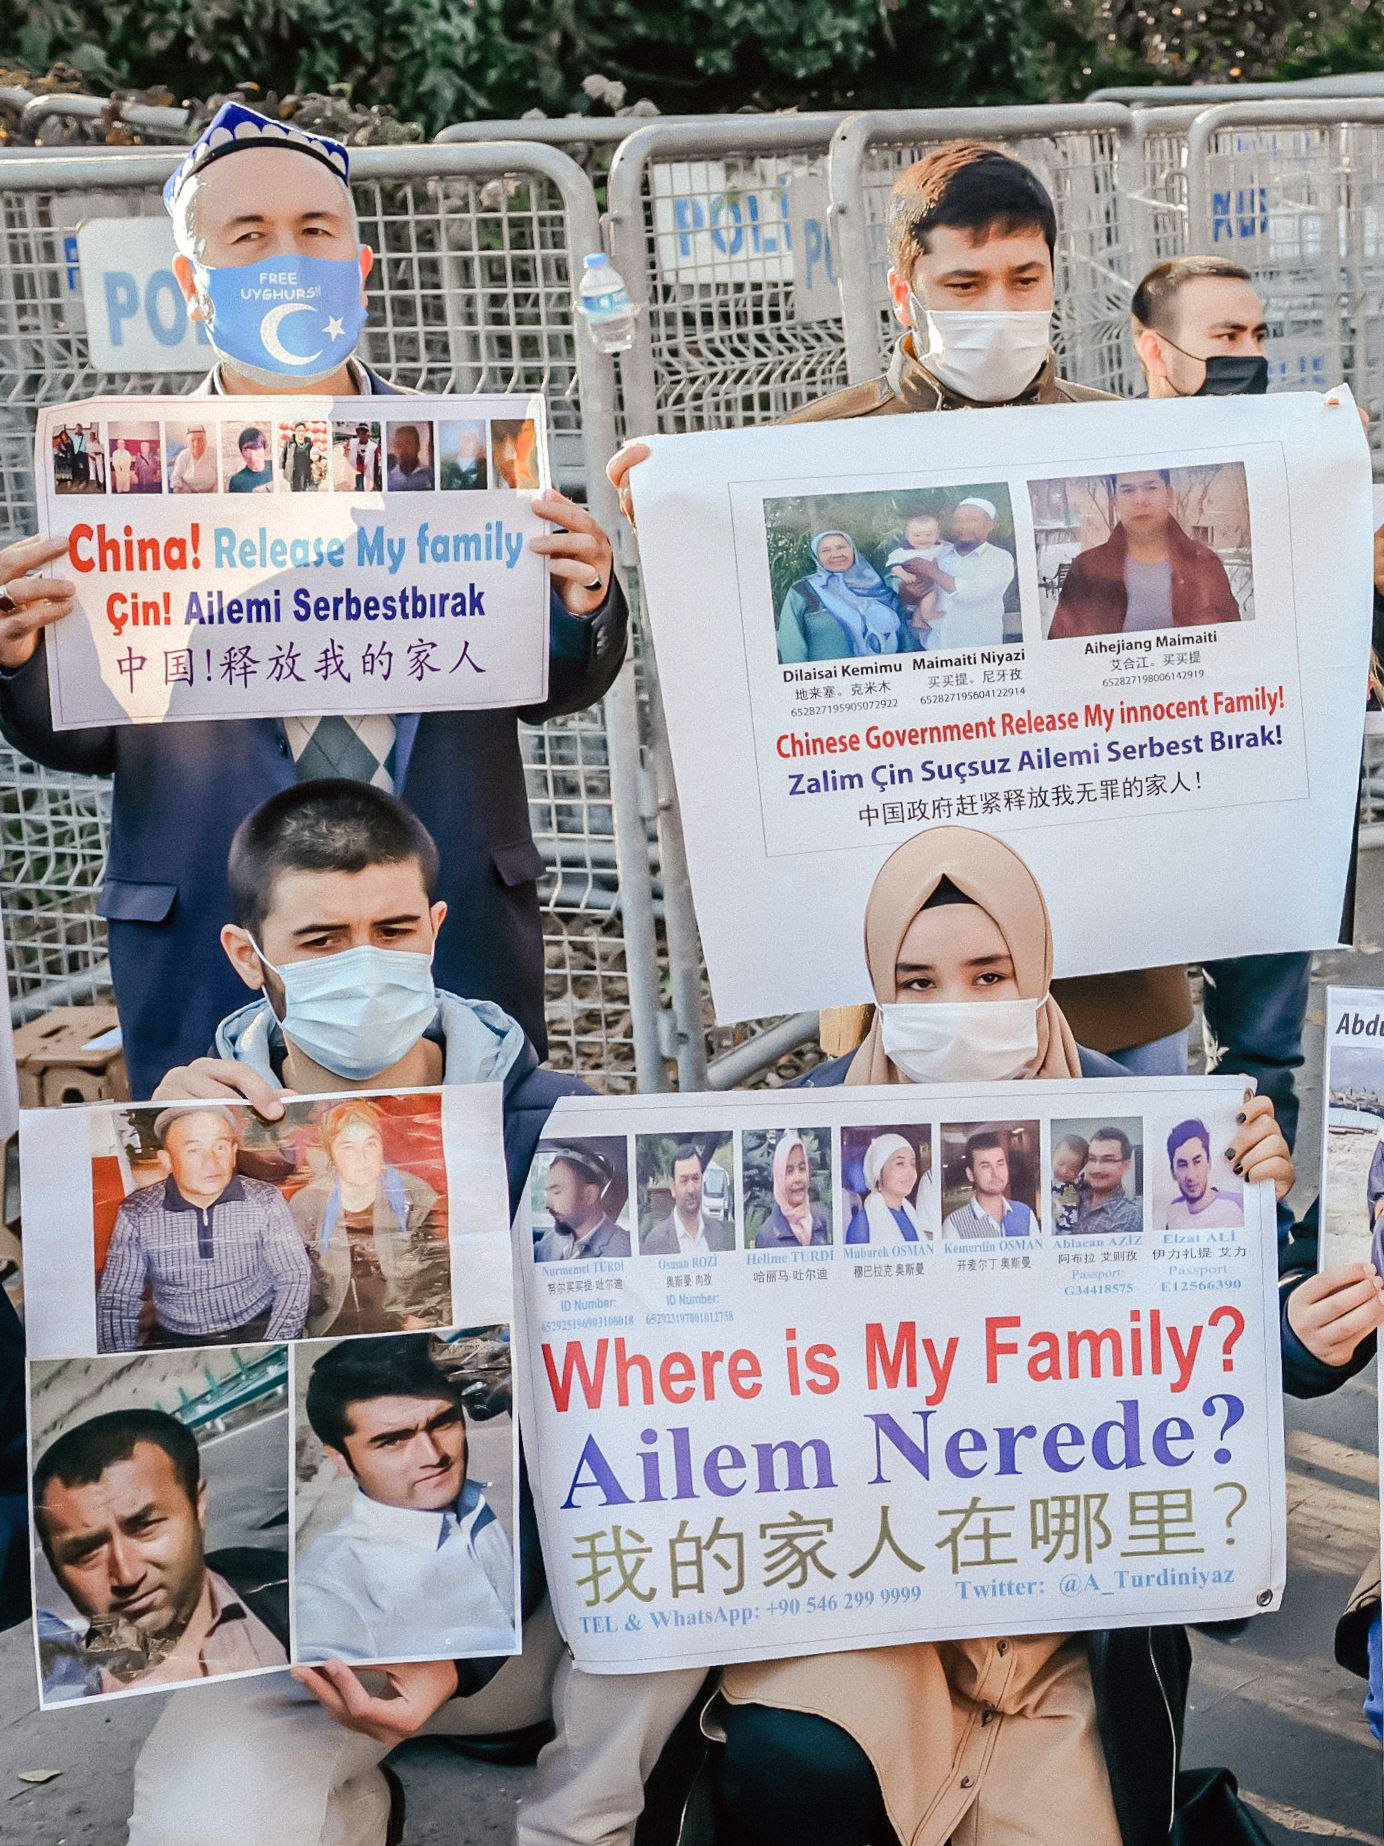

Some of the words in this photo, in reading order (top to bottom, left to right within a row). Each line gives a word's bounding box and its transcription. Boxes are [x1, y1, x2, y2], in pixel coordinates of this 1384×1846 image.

[259, 273, 298, 284] FREE
[69, 523, 200, 573] China!
[215, 528, 345, 569] Release
[358, 525, 406, 574] My
[417, 521, 523, 569] family
[107, 592, 170, 635] Çin!
[184, 589, 281, 625] Ailemi
[294, 583, 485, 621] Serbestbırak
[1085, 639, 1151, 655] Aihejiang
[1156, 631, 1217, 647] Maimaiti
[912, 653, 977, 671] Maimaiti
[981, 649, 1025, 666] Niyazi
[783, 668, 837, 683] Dilaisai
[842, 663, 902, 677] Kemimu
[776, 728, 860, 759] Chinese
[866, 716, 996, 752] Government
[1001, 709, 1079, 735] Release
[1084, 704, 1115, 734] My
[1120, 691, 1209, 726] innocent
[1213, 685, 1285, 720] Family!
[789, 766, 863, 796] Zalim
[871, 764, 913, 793] Çin
[921, 754, 1011, 788] Suçsuz
[1019, 743, 1100, 773] Ailemi
[1108, 734, 1203, 766] Serbest
[1210, 724, 1283, 756] Bırak!
[1000, 1240, 1043, 1250] OSMAN
[1053, 1239, 1104, 1249] Ablacan
[1163, 1234, 1199, 1244] Elzat
[746, 1252, 787, 1265] Helime
[844, 1246, 888, 1259] Mubarek
[892, 1244, 934, 1257] OSMAN
[658, 1259, 688, 1270] Osman
[1161, 1279, 1241, 1292] E12566390
[561, 1300, 571, 1312] ID
[666, 1294, 676, 1305] ID
[542, 1335, 763, 1412] Where
[785, 1329, 840, 1396] is
[865, 1321, 960, 1406] My
[985, 1307, 1246, 1394] Family?
[560, 1428, 838, 1510] Ailem
[865, 1393, 1246, 1486] Nerede?
[955, 1576, 1046, 1599] Twitter:
[1059, 1566, 1235, 1597] @A_Turdiniyaz
[580, 1616, 620, 1635] TEL
[624, 1612, 641, 1632] &
[649, 1602, 759, 1631] WhatsApp:
[765, 1598, 800, 1619] +90
[806, 1594, 838, 1614] 546
[844, 1590, 875, 1611] 299
[881, 1585, 922, 1608] 9999
